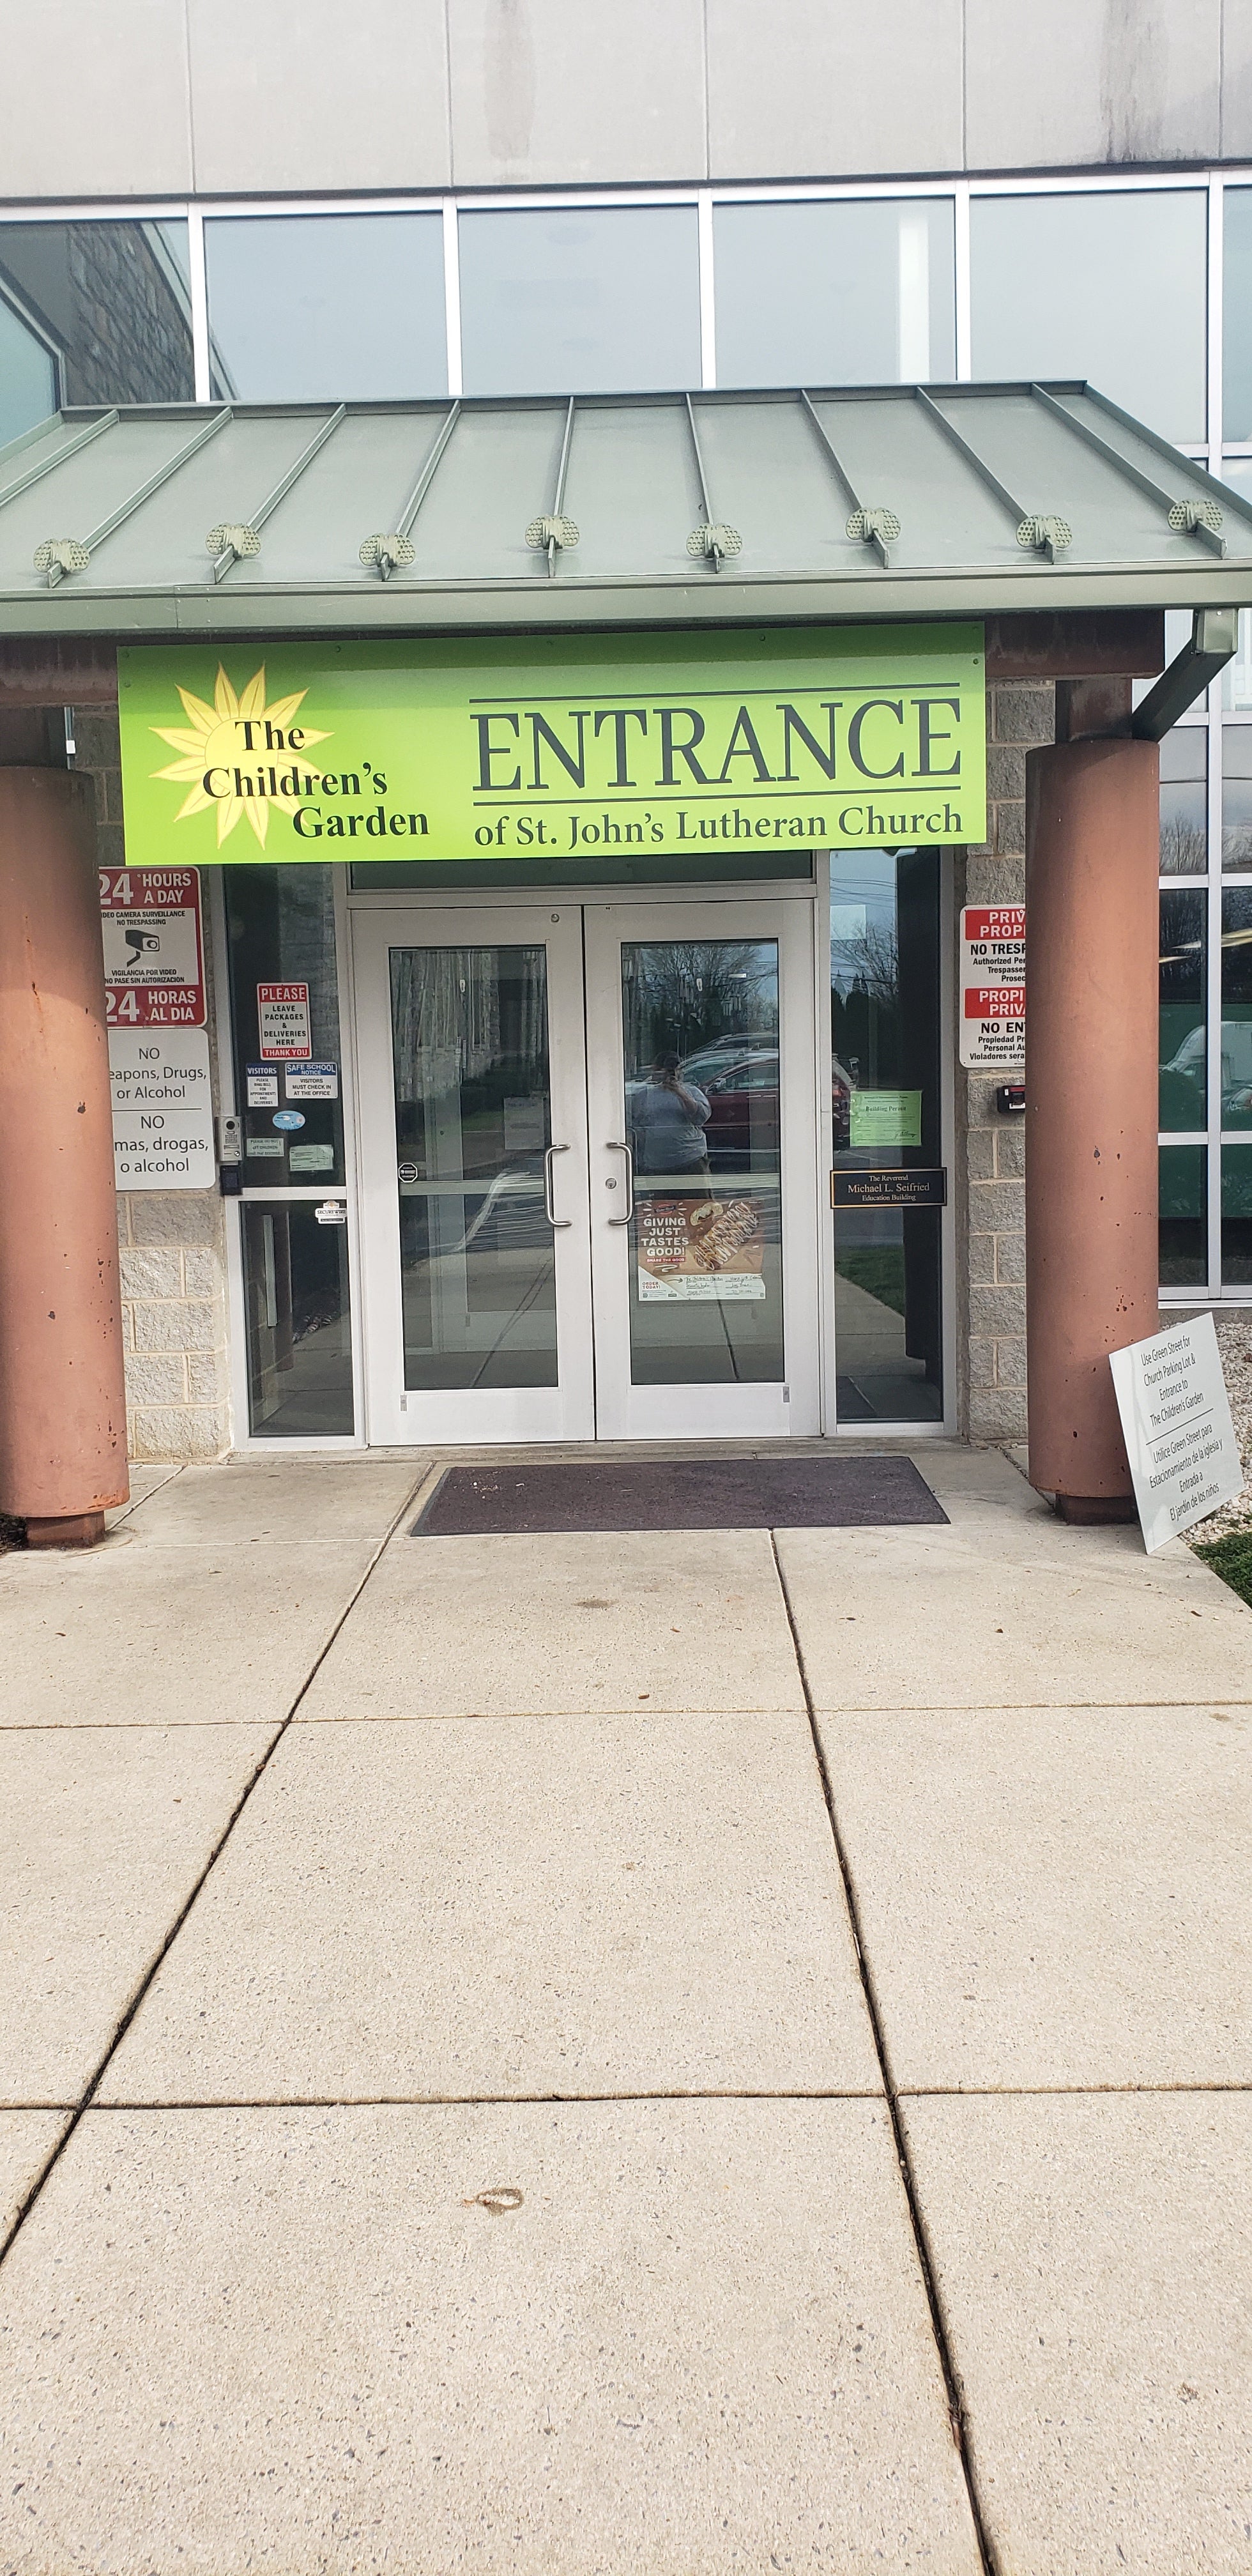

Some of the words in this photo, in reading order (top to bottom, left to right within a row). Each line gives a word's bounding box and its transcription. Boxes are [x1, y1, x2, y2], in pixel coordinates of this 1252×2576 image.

[234, 720, 305, 751] The
[470, 698, 961, 791] ENTRANCE
[202, 762, 387, 798] Children's
[293, 806, 430, 838] Garden
[475, 816, 507, 846] of
[516, 817, 558, 845] St.
[569, 814, 663, 850] John's
[676, 808, 828, 840] Lutheran
[839, 804, 963, 835] Church
[99, 873, 134, 905] 24
[142, 873, 192, 887] HOURS
[144, 890, 154, 903] A
[157, 889, 183, 903] DAY
[980, 924, 1025, 938] PROP
[970, 944, 987, 955] NO
[973, 957, 1012, 965] Authorized
[261, 987, 305, 1000] PLEASE
[105, 991, 140, 1022] 24
[148, 990, 196, 1004] HORAS
[150, 1008, 168, 1021] AL
[171, 1007, 195, 1020] DIA
[981, 1022, 1000, 1034] NO
[1006, 1022, 1025, 1033] EN
[978, 1036, 1014, 1045] Propiedad
[139, 1048, 160, 1059] NO
[164, 1067, 206, 1081] Drugs,
[287, 1064, 305, 1073] SAFE
[307, 1064, 336, 1073] SCHOOL
[117, 1089, 131, 1099] or
[135, 1085, 185, 1099] Alcohol
[141, 1116, 165, 1129] NO
[153, 1137, 208, 1153] drogas,
[121, 1163, 130, 1172] o
[134, 1158, 189, 1172] alcohol
[848, 1184, 882, 1193] Michael
[884, 1184, 894, 1192] L.
[896, 1183, 929, 1192] Seifried
[643, 1218, 686, 1227] GIVING
[649, 1227, 681, 1236] JUST
[641, 1238, 689, 1246] TASTES
[647, 1247, 685, 1257] GOOD!
[1141, 1353, 1152, 1366] Use
[1152, 1346, 1168, 1361] Green
[1168, 1339, 1184, 1354] Street
[1143, 1367, 1163, 1386] Church
[1163, 1361, 1182, 1377] Parking
[1182, 1356, 1191, 1368] Lot
[1190, 1353, 1196, 1365] &
[1159, 1382, 1182, 1401] Entrance
[1182, 1379, 1188, 1390] to
[1150, 1413, 1161, 1427] The
[1161, 1399, 1186, 1422] Children's
[1185, 1392, 1204, 1409] Garden
[1153, 1446, 1171, 1464] Utilice
[1170, 1438, 1186, 1453] Green
[1186, 1428, 1202, 1446] Street
[1202, 1424, 1212, 1440] para
[1150, 1457, 1192, 1489] Estacionamiento
[1192, 1450, 1199, 1464] de
[1198, 1448, 1204, 1459] la
[1203, 1439, 1219, 1459] iglesia
[1218, 1438, 1223, 1451] y
[1179, 1471, 1199, 1493] Entrada
[1199, 1471, 1203, 1481] a
[1170, 1506, 1176, 1521] El
[1191, 1494, 1198, 1508] de
[1197, 1491, 1206, 1504] los
[1205, 1483, 1219, 1498] niños
